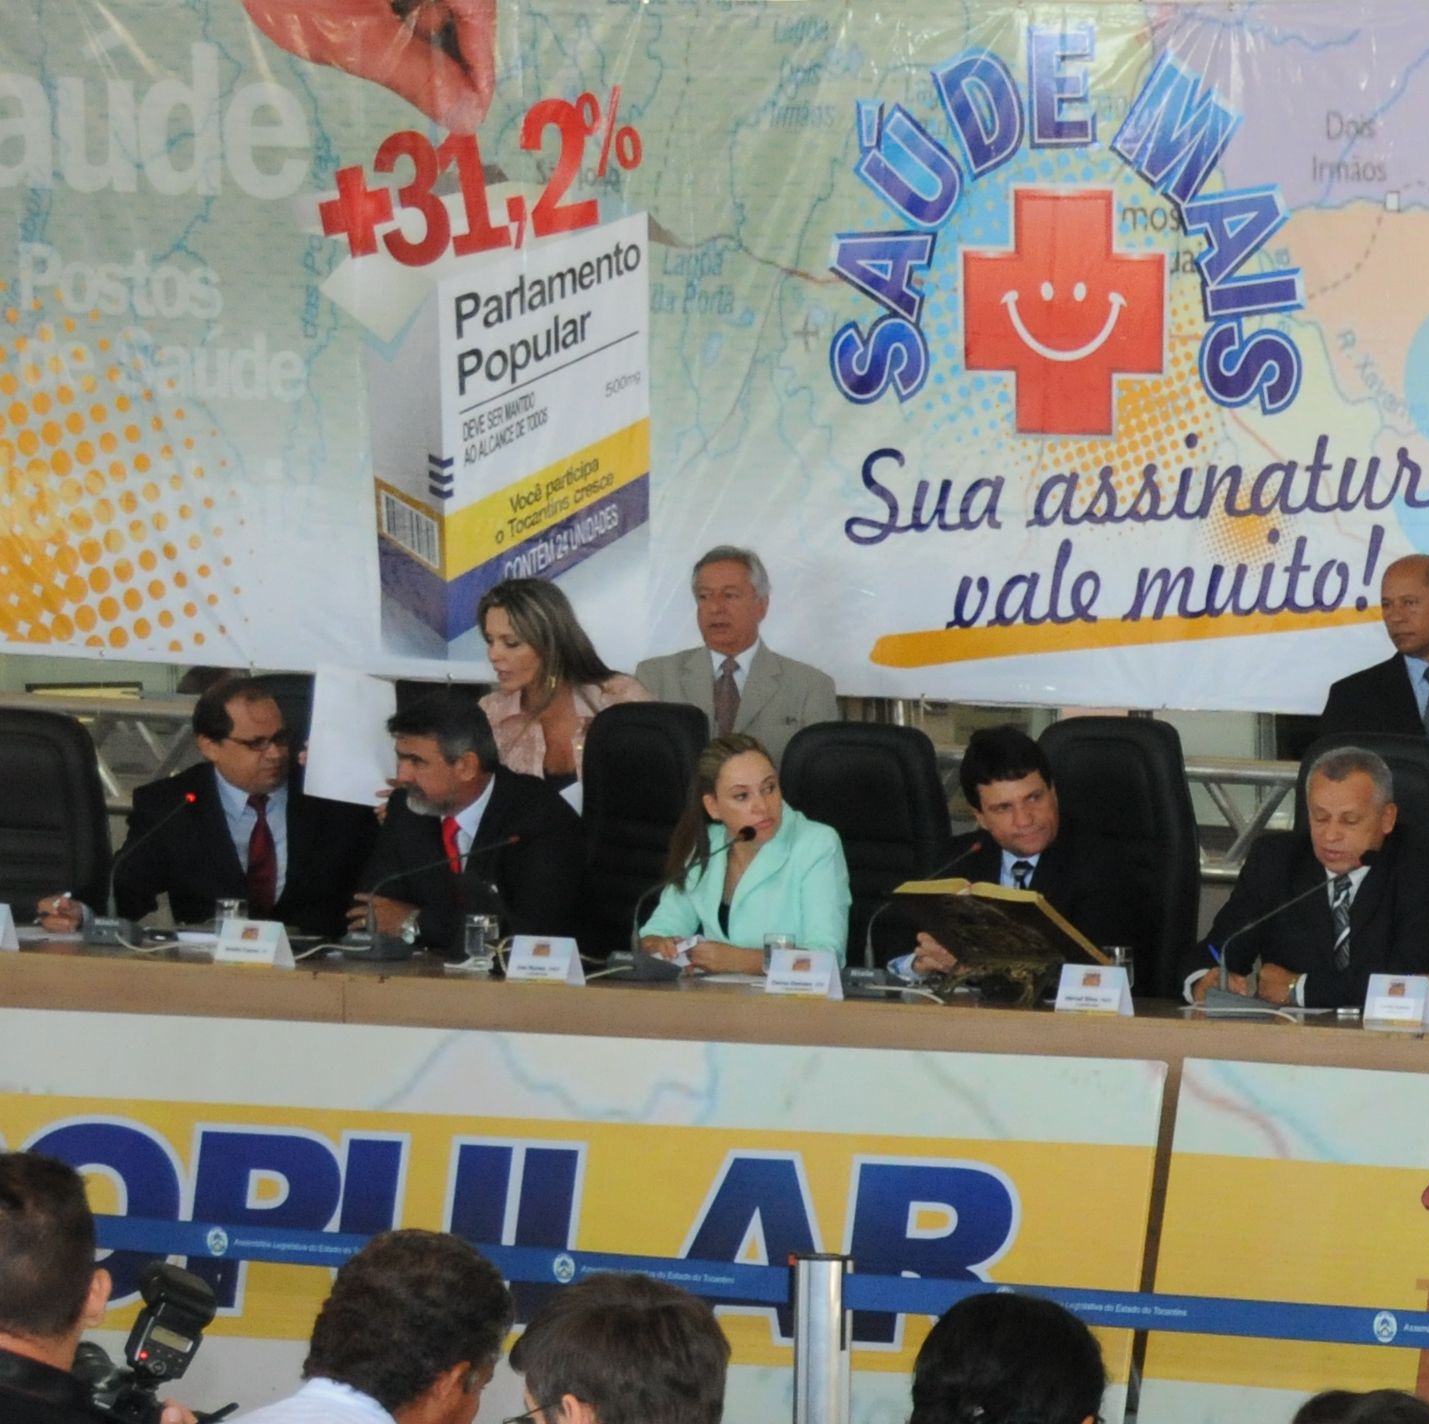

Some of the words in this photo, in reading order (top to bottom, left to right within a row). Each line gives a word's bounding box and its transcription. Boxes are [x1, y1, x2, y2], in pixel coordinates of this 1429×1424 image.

[1325, 111, 1376, 141] Dois
[320, 85, 642, 267] +31,2%
[1311, 155, 1387, 183] Irmãos
[830, 24, 1098, 406] SAÚDE
[1109, 48, 1306, 417] MAIS
[19, 243, 226, 321] Postos
[454, 241, 641, 341] Parlamento
[457, 310, 592, 396] Popular
[604, 371, 641, 398] 500mg
[462, 412, 486, 443] DEVE
[487, 404, 504, 431] SER
[504, 391, 537, 421] MANTIDO
[464, 441, 478, 467] AO
[478, 426, 515, 458] ALCANCE
[515, 420, 527, 441] DE
[509, 483, 543, 514] Você
[545, 457, 600, 499] participa
[845, 447, 1004, 547] Sua
[945, 538, 1101, 631] vale
[1121, 524, 1385, 624] muito!
[1114, 1304, 1140, 1314] Estado
